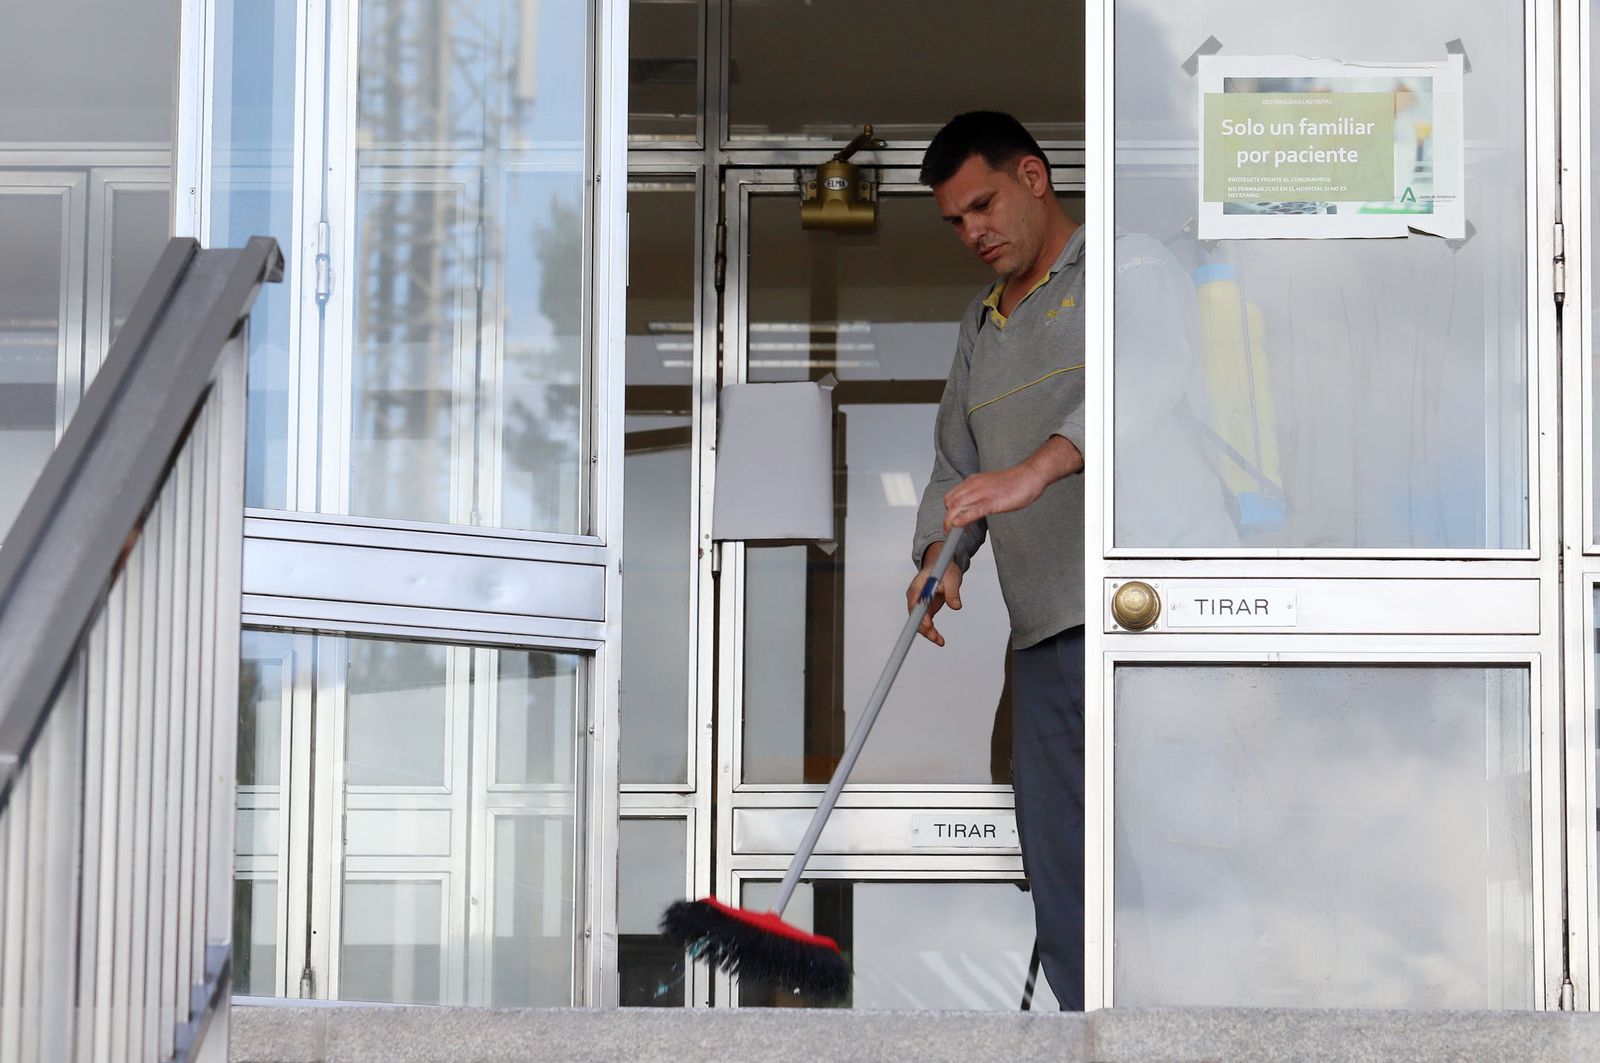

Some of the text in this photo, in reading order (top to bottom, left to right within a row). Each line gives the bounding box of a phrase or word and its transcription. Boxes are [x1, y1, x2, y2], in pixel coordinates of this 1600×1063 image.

[1221, 118, 1375, 136] Solo un familiar
[1237, 145, 1359, 168] por paciente
[828, 180, 846, 188] ELMA
[1194, 598, 1269, 616] TIRAR
[933, 823, 996, 838] TIRAR
